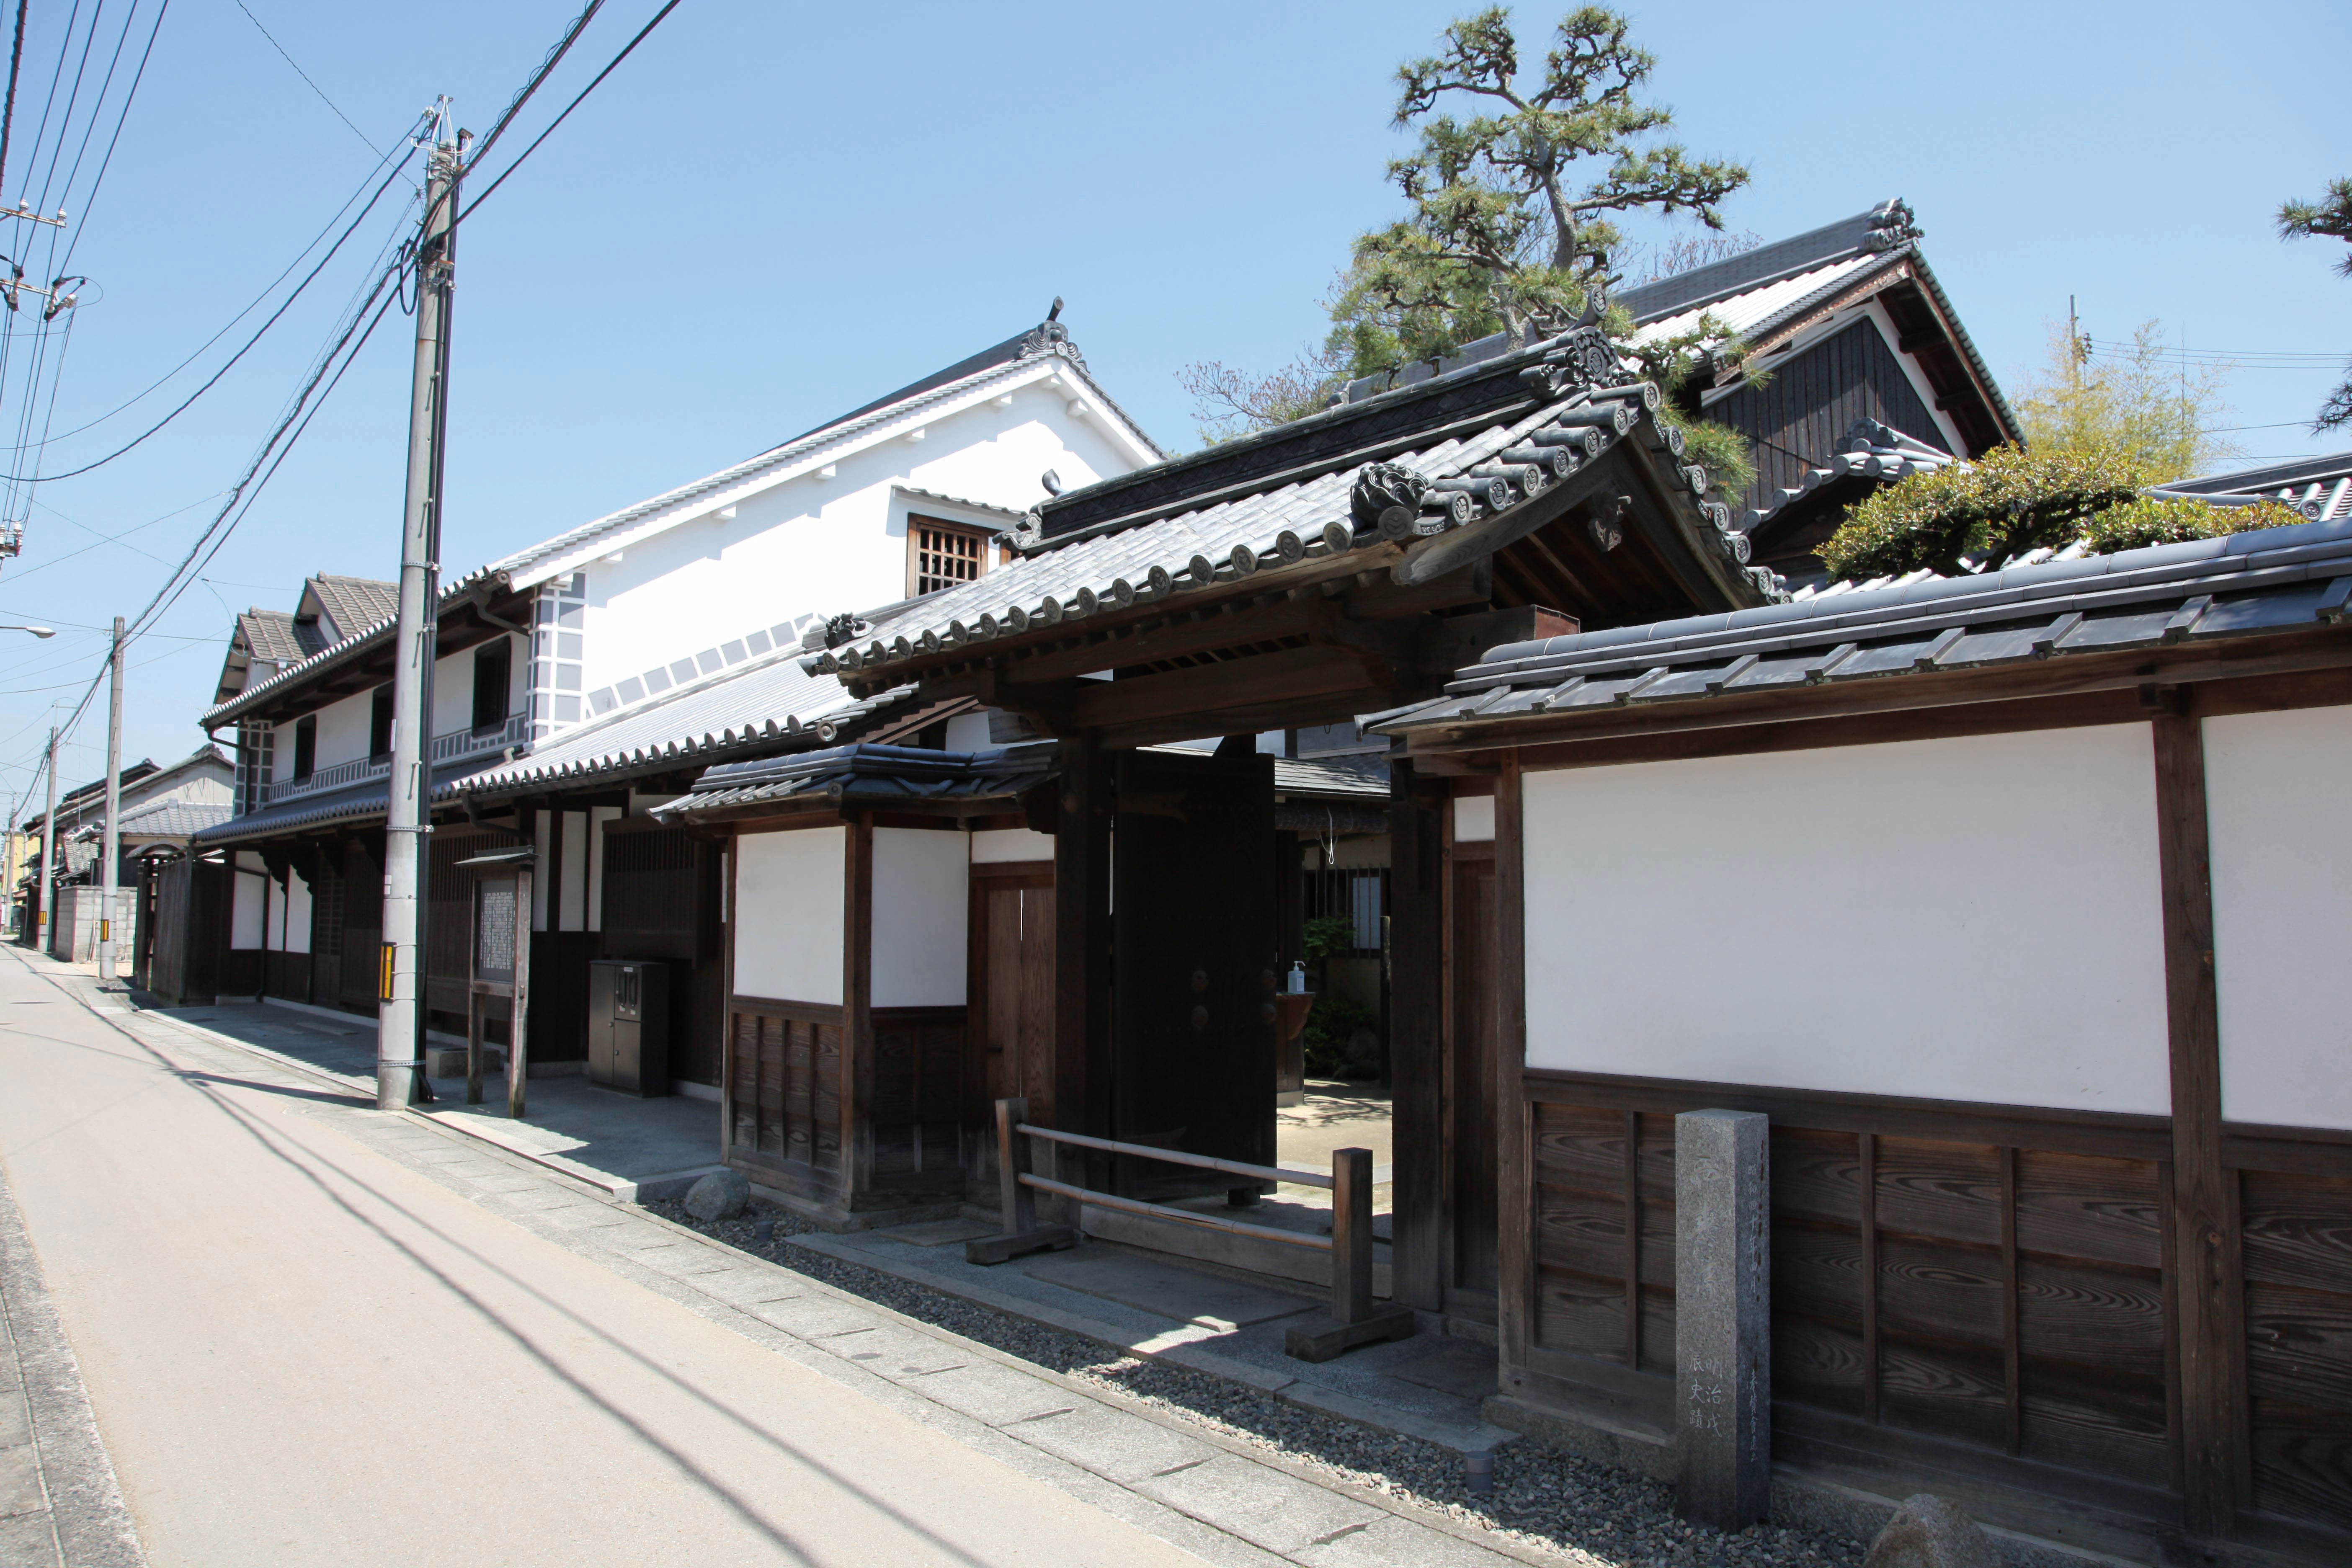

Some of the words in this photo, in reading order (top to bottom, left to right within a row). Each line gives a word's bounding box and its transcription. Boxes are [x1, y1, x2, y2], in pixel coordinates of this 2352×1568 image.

[1688, 1352, 1705, 1429] 辰史蹟
[1705, 1357, 1723, 1438] 明治戊
